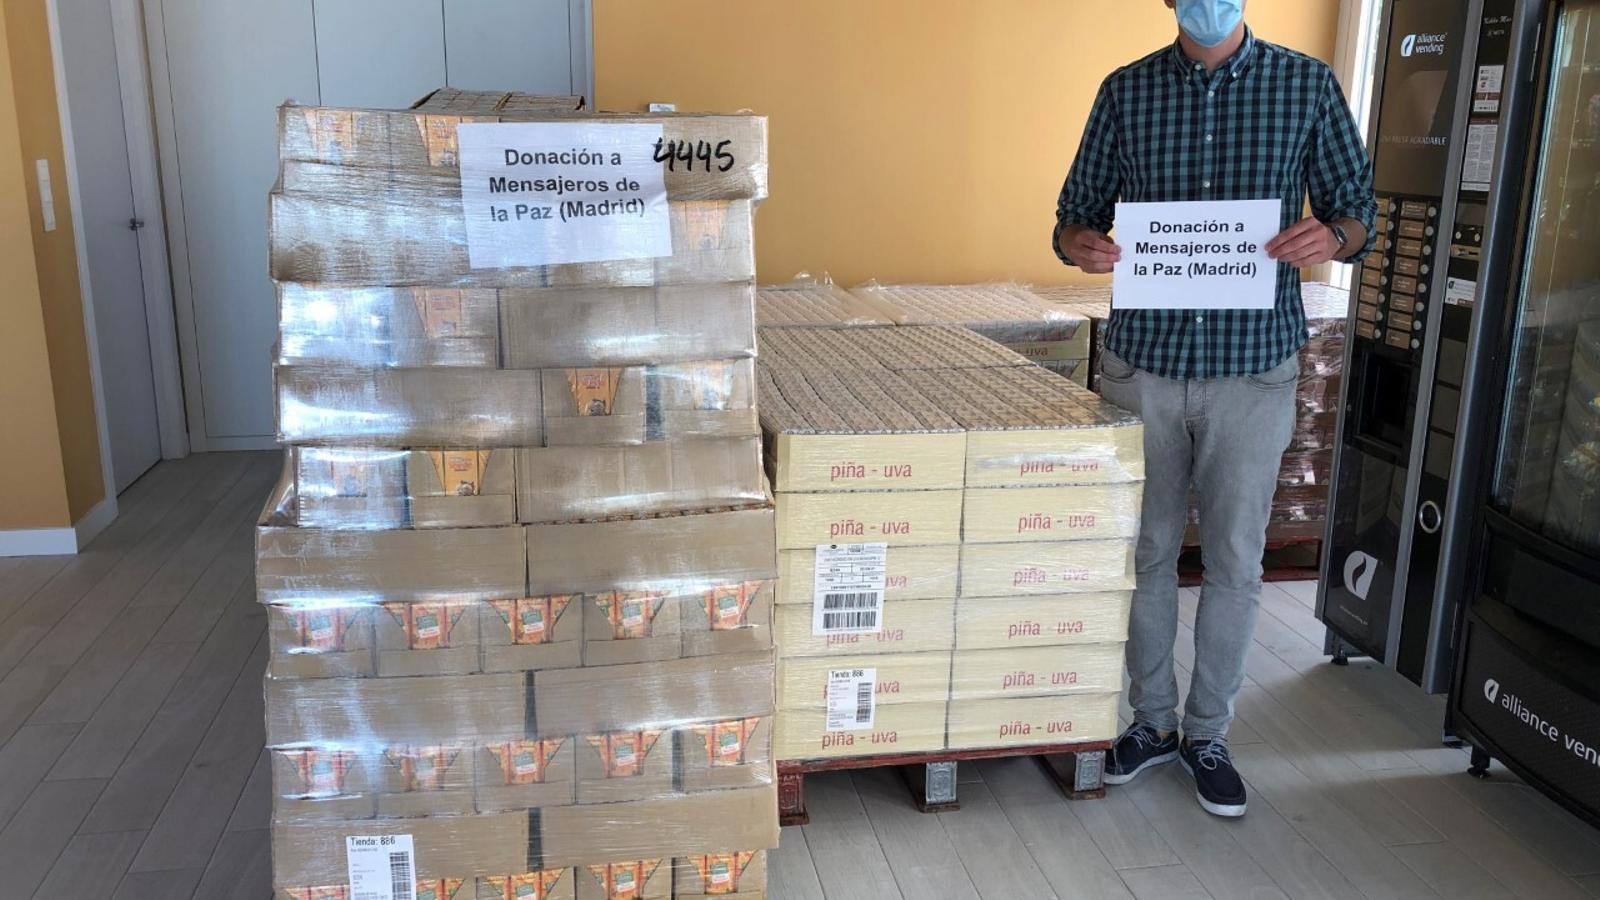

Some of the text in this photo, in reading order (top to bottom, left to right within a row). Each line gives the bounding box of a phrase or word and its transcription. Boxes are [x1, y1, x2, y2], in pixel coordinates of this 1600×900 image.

[1416, 33, 1445, 43] alliance
[1415, 44, 1445, 55] vending
[504, 148, 622, 166] Donación a
[653, 136, 735, 173] 4445
[489, 176, 641, 195] Mensajeros de
[490, 198, 645, 223] la Paz (Madrid)
[1149, 219, 1245, 234] Donación a
[1135, 241, 1257, 257] Mensajeros de
[1133, 261, 1257, 279] la Paz (Madrid)
[830, 461, 866, 481] piña
[884, 463, 912, 478] uva
[830, 519, 864, 539] piña
[881, 521, 910, 535] uva
[1018, 513, 1052, 533] piña
[1067, 514, 1096, 528] uva
[1014, 567, 1047, 587] piña
[1063, 569, 1089, 581] uva
[876, 629, 905, 642] uva
[1008, 620, 1083, 640] piña uva
[1003, 671, 1034, 690] piña
[1051, 671, 1077, 685] uva
[999, 720, 1032, 739] piña
[1046, 719, 1073, 734] uva
[1501, 693, 1600, 767] alliance ven
[822, 731, 854, 749] piña
[871, 730, 897, 744] uva
[351, 837, 378, 846] Tienda:
